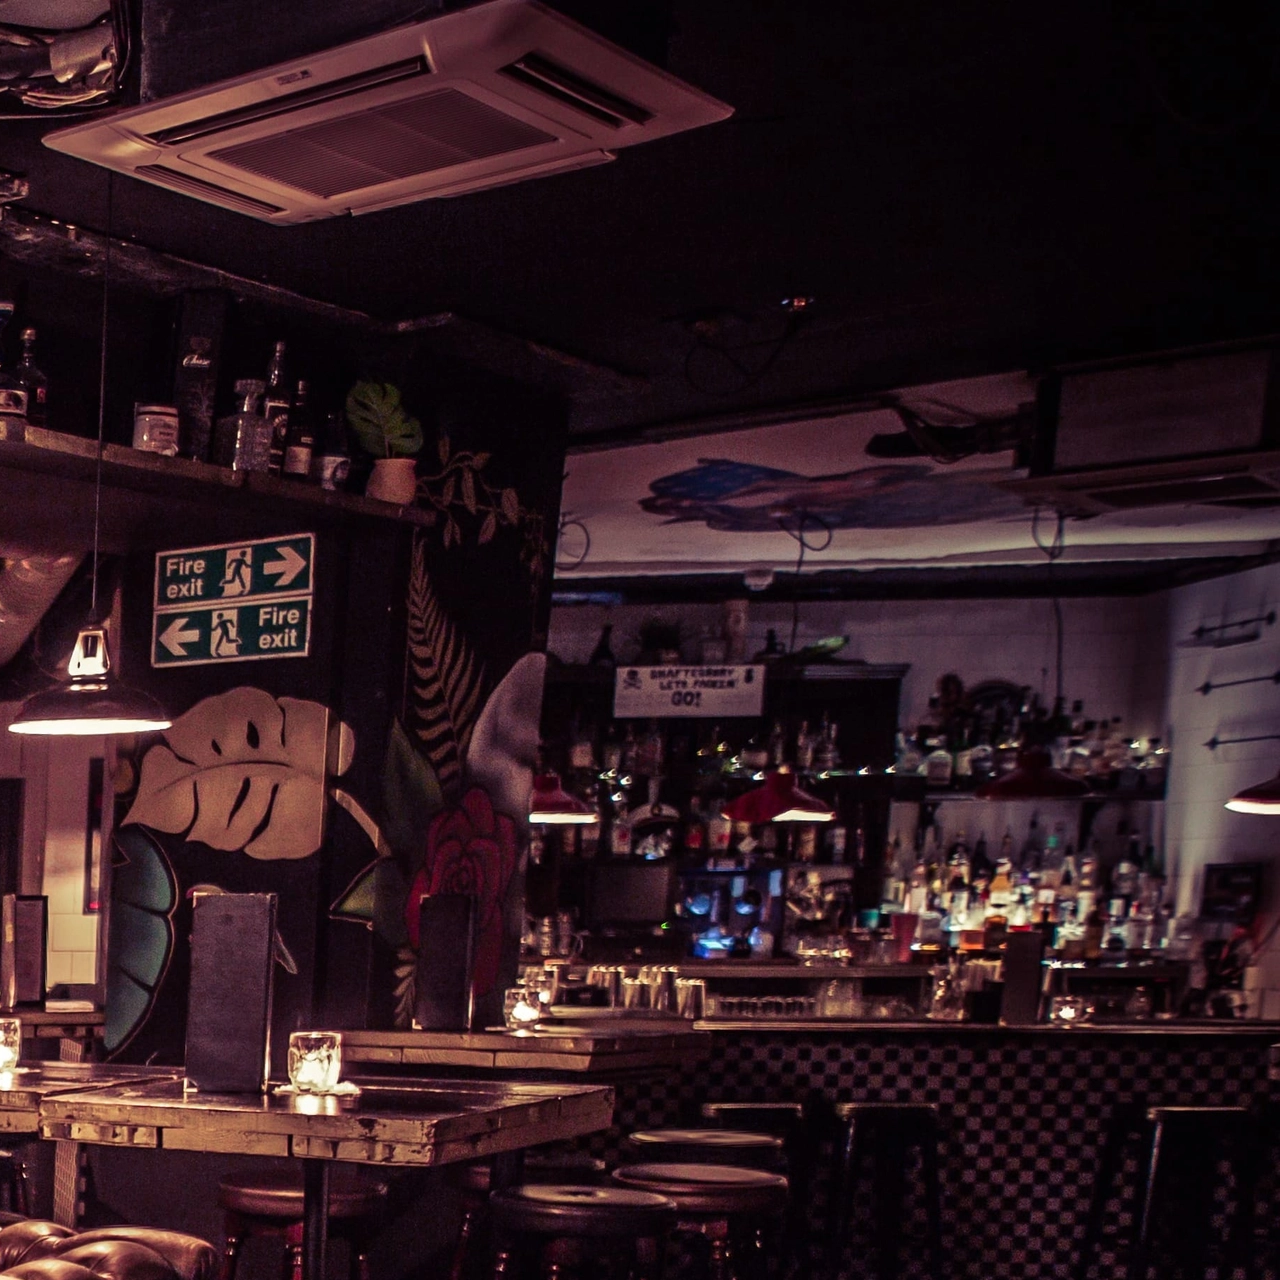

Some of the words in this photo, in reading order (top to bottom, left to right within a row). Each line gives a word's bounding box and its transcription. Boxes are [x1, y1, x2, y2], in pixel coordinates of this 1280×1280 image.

[166, 557, 205, 577] Fire
[166, 579, 204, 599] exit
[259, 606, 300, 627] Fire
[259, 629, 297, 649] exit
[671, 690, 702, 708] GO!
